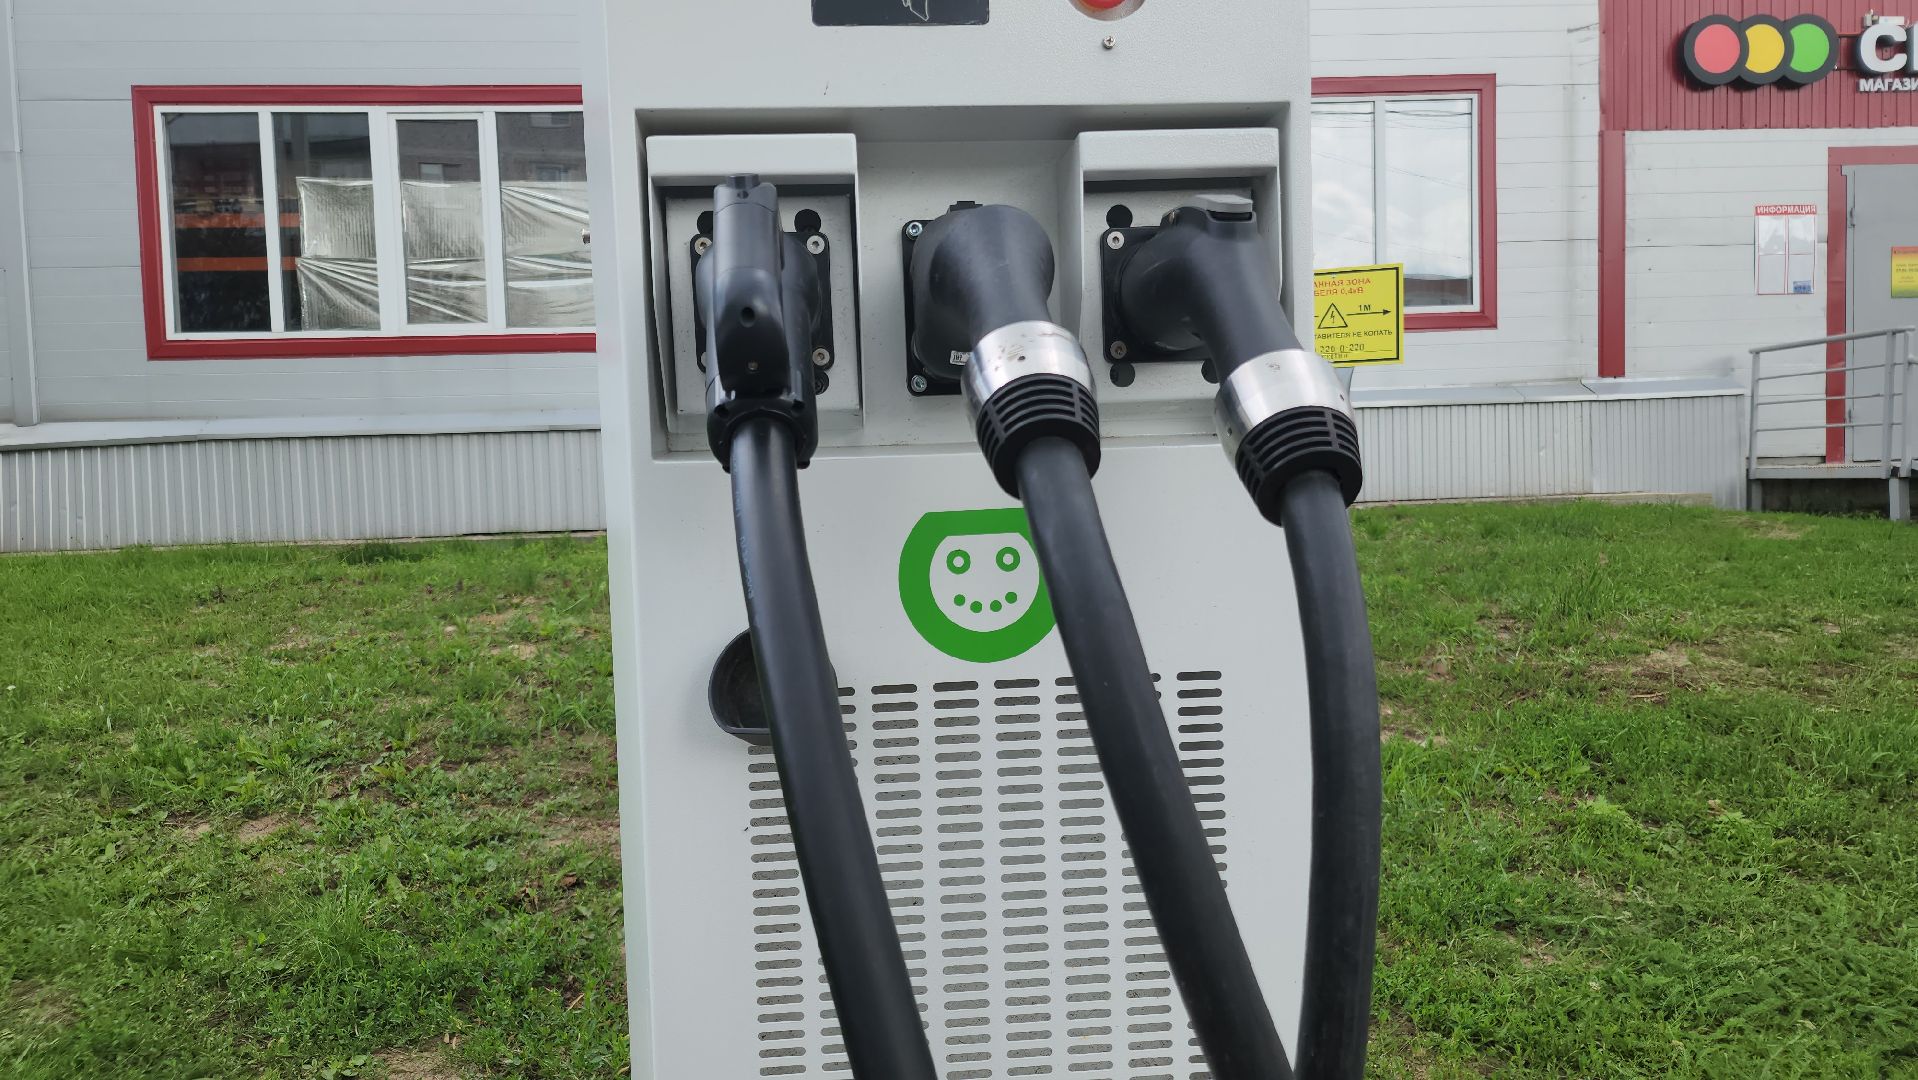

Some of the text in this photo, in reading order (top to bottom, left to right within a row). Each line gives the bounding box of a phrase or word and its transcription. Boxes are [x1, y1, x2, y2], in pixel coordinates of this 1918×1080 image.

[1859, 22, 1918, 73] С
[1859, 77, 1918, 92] МАГАЗИ
[1757, 205, 1816, 214] ИНФОРМАЦИЯ
[1346, 278, 1371, 286] ЗОНА
[1363, 329, 1393, 337] КОПАТЬ
